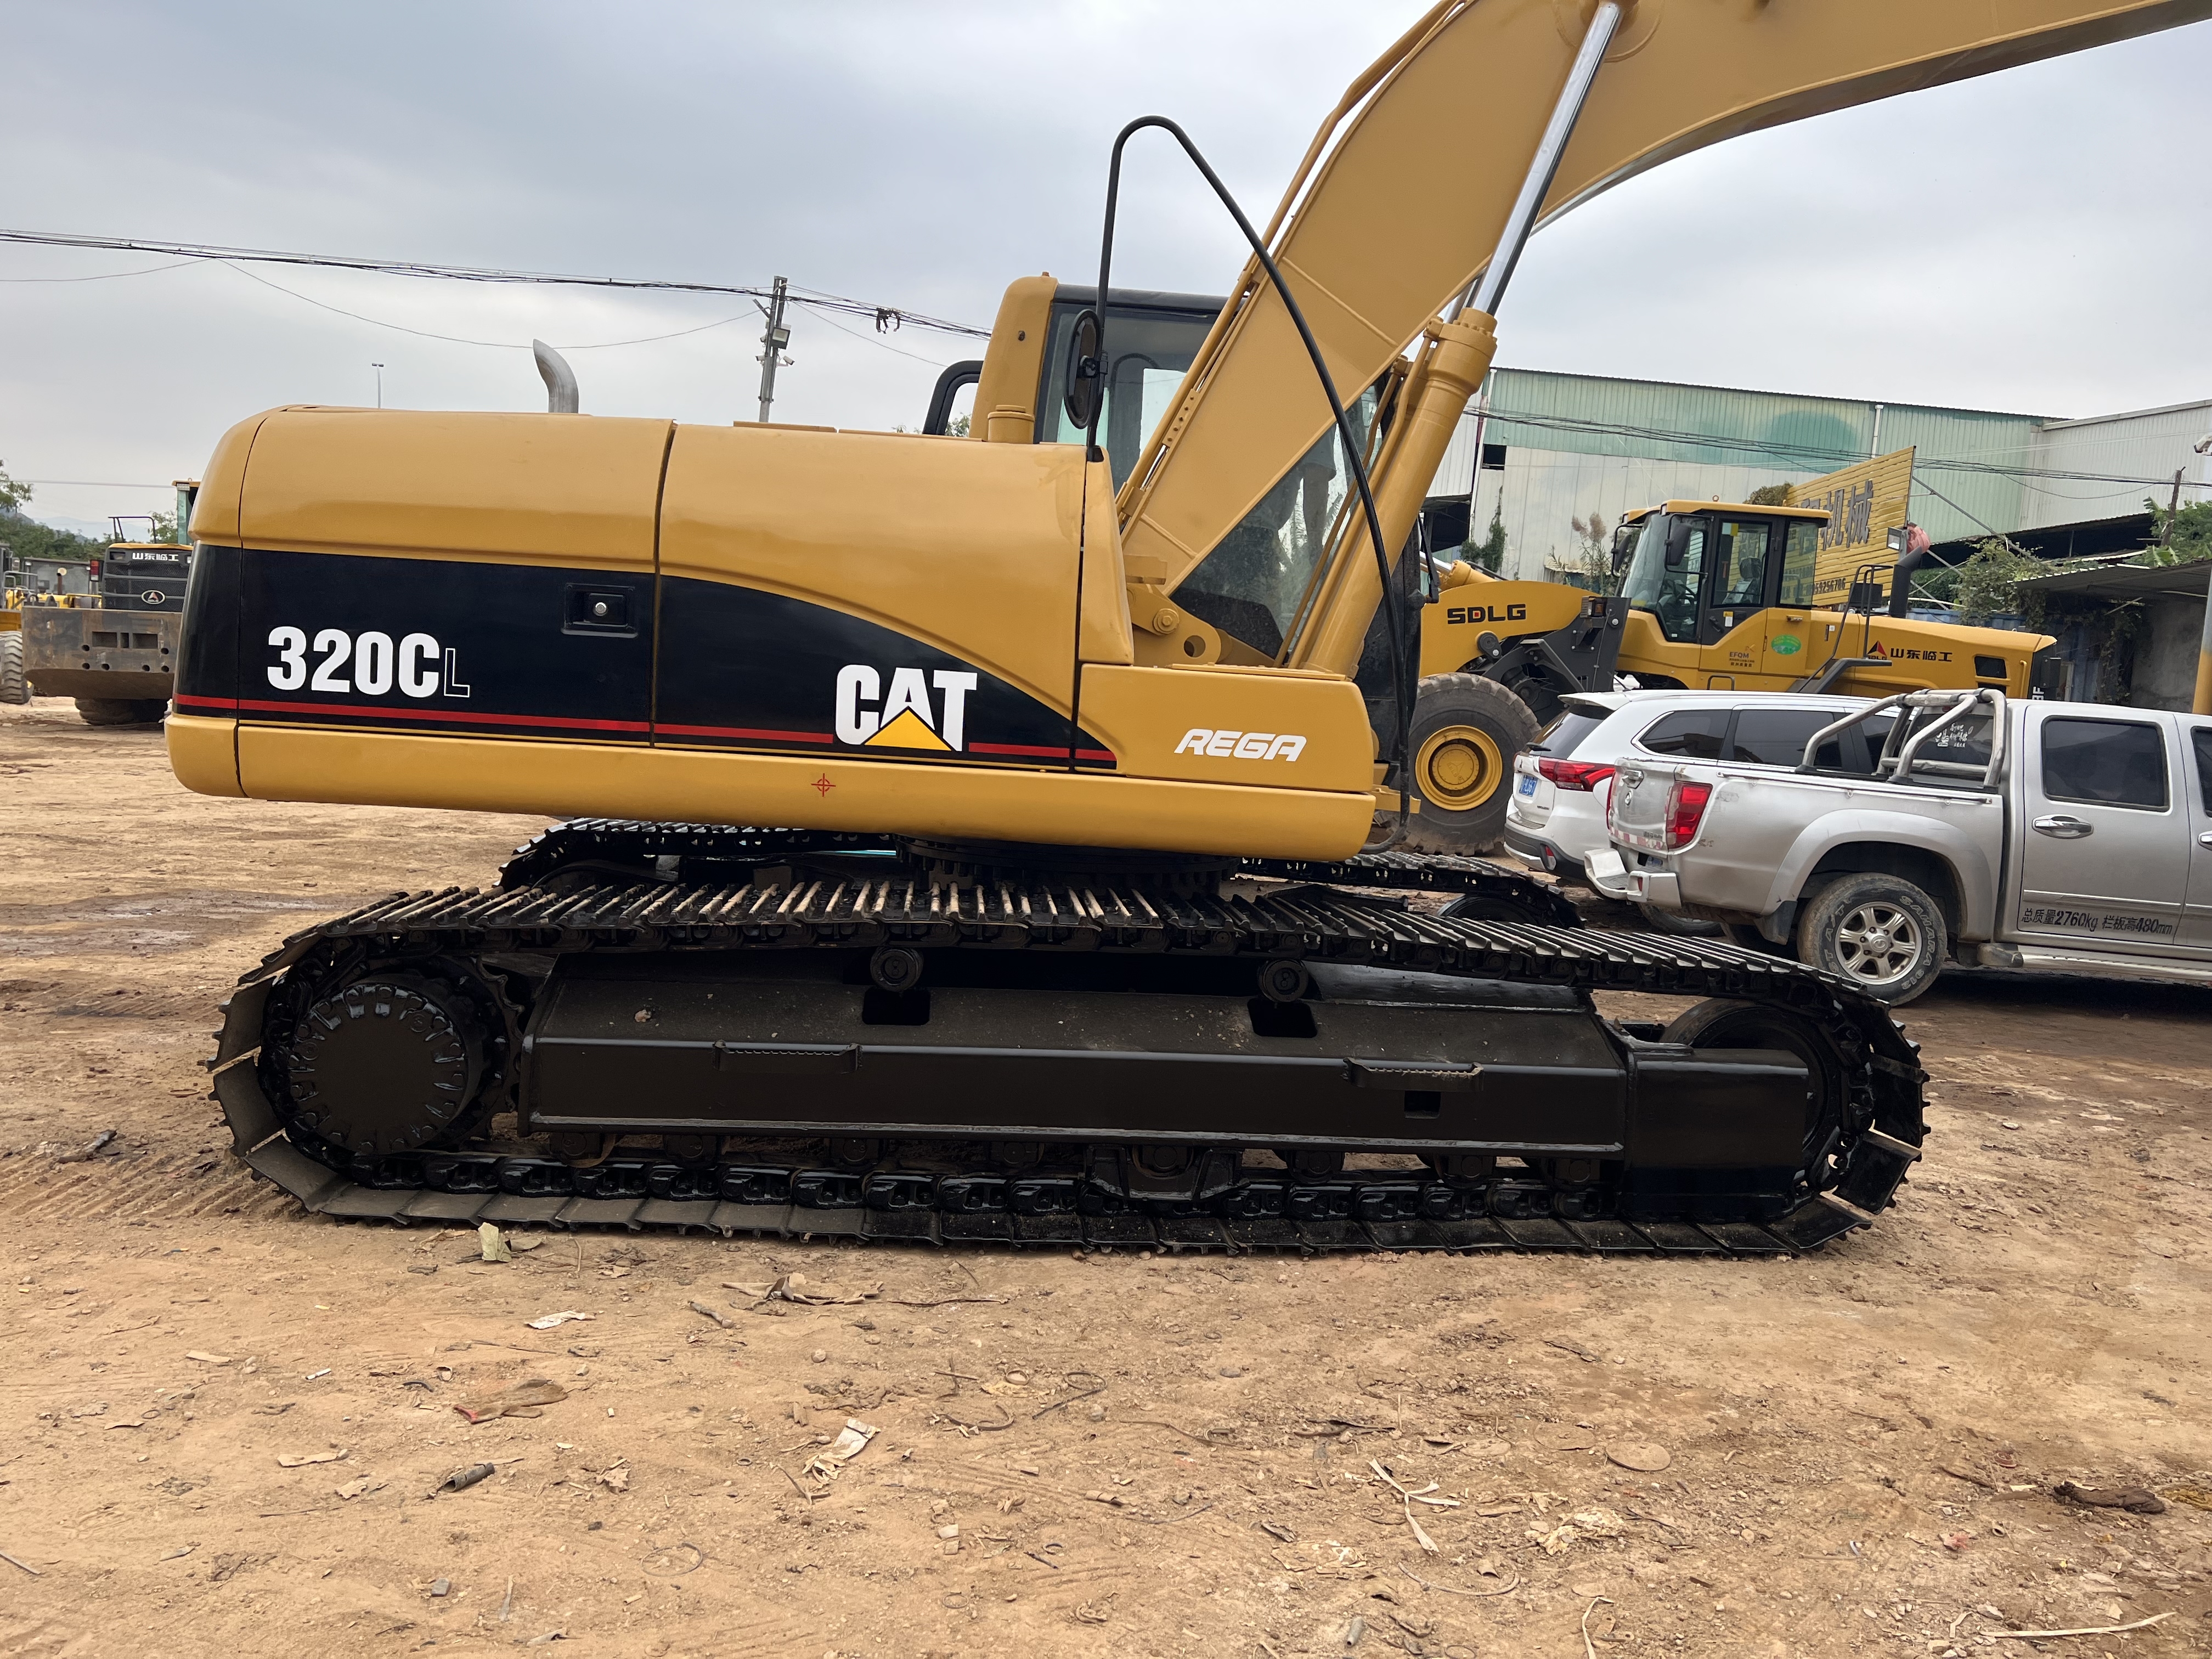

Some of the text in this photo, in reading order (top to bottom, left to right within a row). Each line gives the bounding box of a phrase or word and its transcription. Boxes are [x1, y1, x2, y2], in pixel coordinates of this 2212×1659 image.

[1801, 479, 1874, 551] 机械
[132, 552, 179, 561] 山东临工
[1447, 603, 1526, 624] SDLG
[1891, 648, 1953, 662] 山东临工
[836, 664, 978, 752] CAT
[1173, 729, 1307, 761] REGA
[2022, 908, 2172, 935] 总质量2760kg 栏板高480mm
[1900, 895, 1936, 990] SAHARA 912
